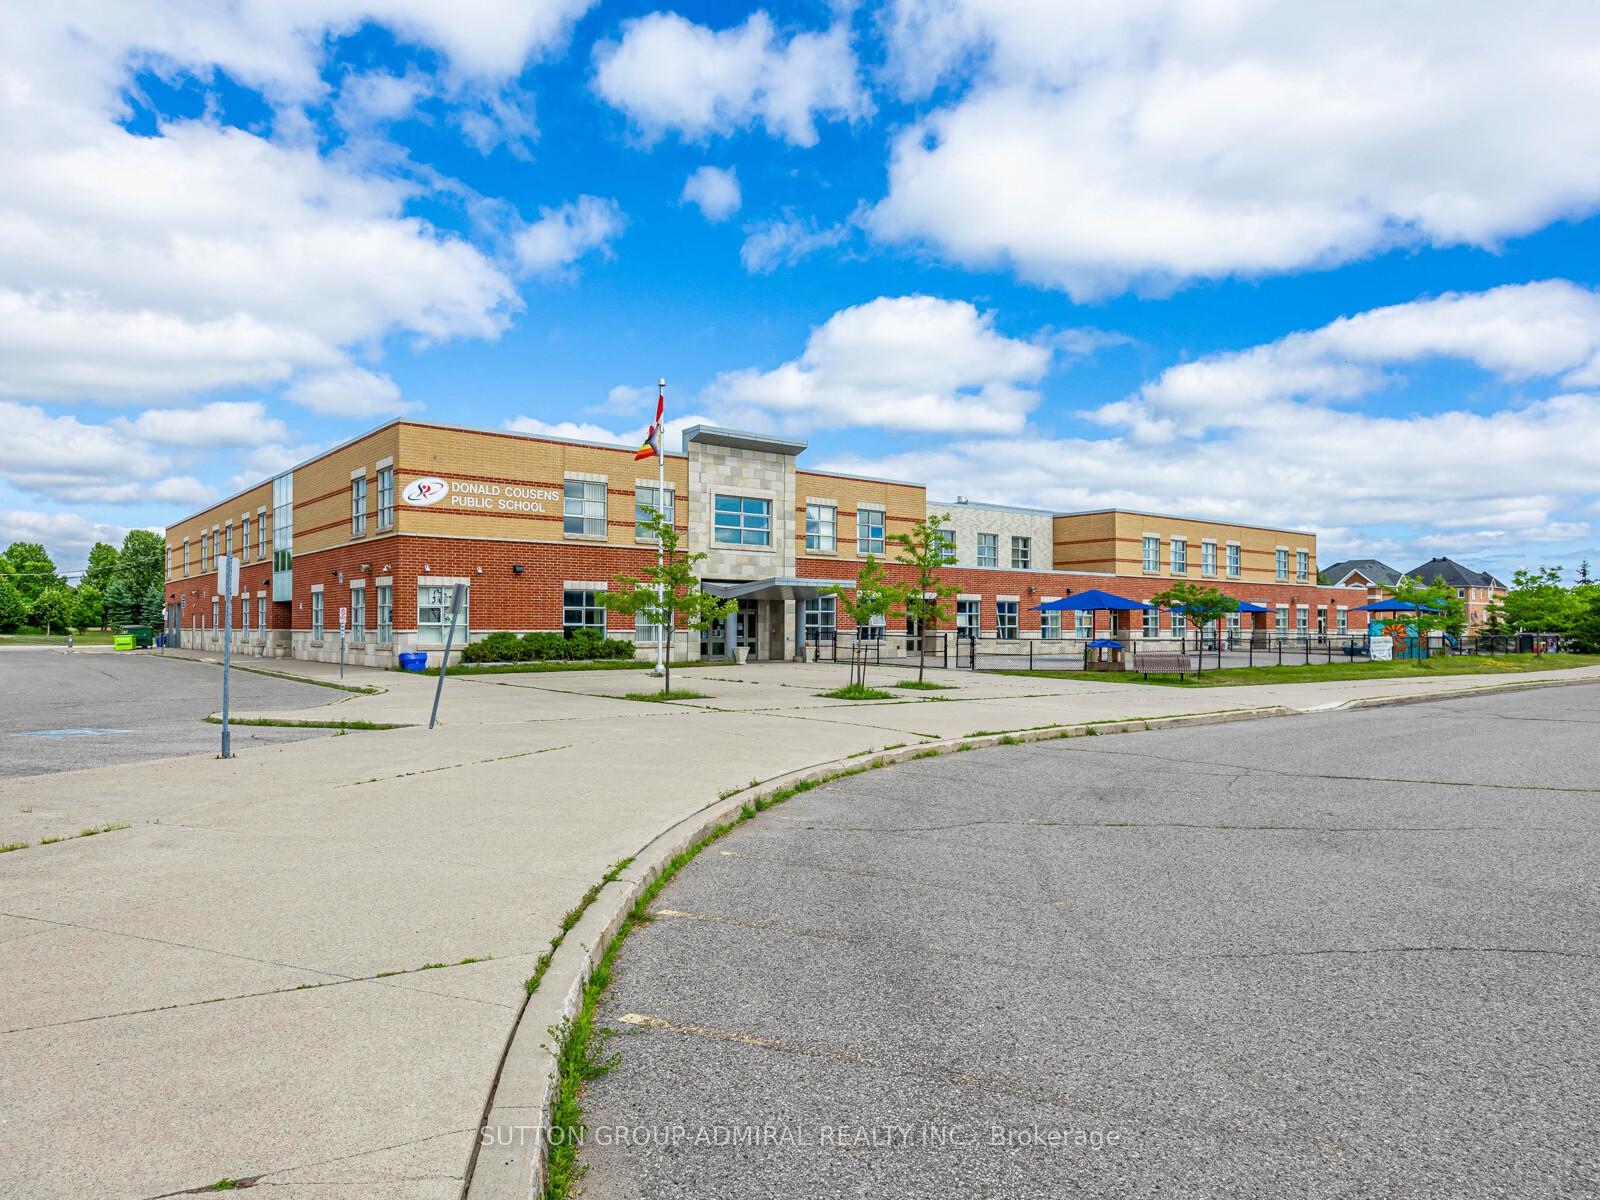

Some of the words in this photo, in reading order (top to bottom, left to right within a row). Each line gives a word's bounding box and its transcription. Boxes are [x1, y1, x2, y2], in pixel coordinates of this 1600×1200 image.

[451, 482, 500, 496] DONALD
[505, 486, 560, 501] COUSENS
[451, 496, 493, 509] PUBLIC
[498, 499, 545, 513] SCHOOL
